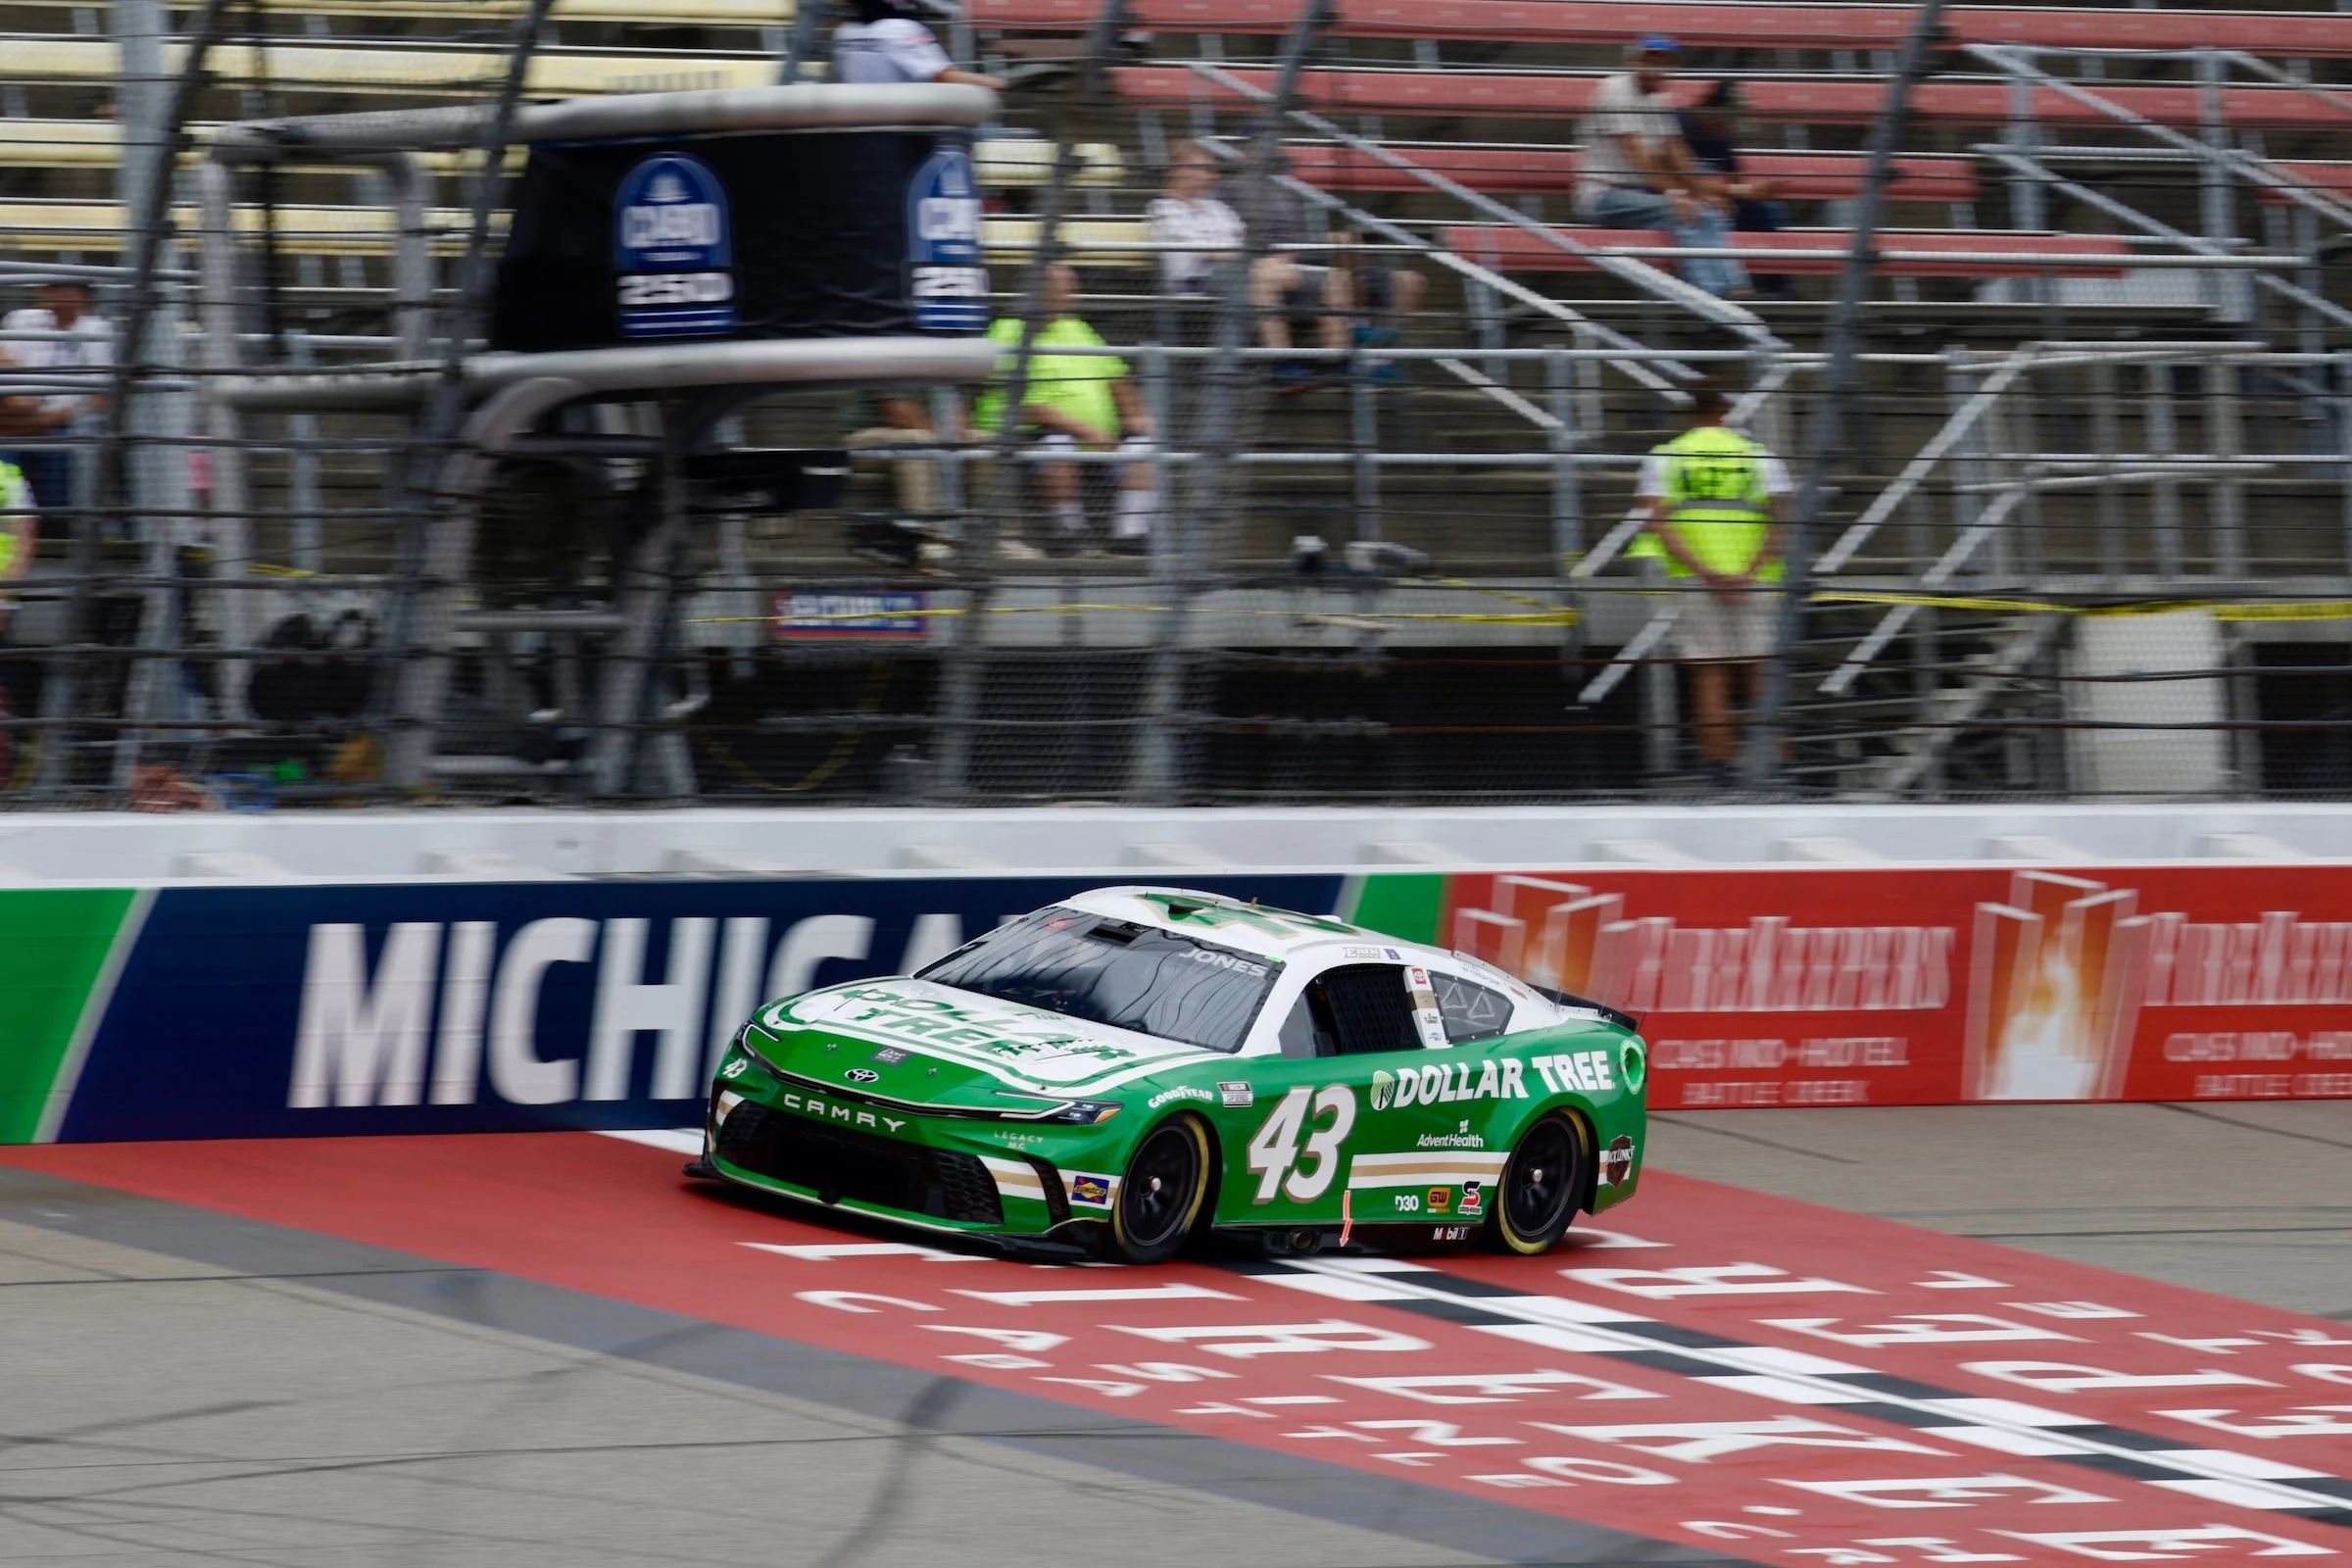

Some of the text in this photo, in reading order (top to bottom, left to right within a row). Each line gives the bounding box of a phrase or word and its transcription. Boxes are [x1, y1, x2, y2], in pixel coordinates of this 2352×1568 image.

[1179, 949, 1267, 978] JONES
[286, 913, 1027, 1108] MICHI
[721, 1057, 748, 1079] 43
[1394, 1057, 1529, 1108] DOLLAR
[1532, 1051, 1615, 1094] TREE
[1148, 1086, 1214, 1108] GOODYEAR
[784, 1093, 906, 1133] CAMRY
[994, 1131, 1045, 1144] LEGACY
[1247, 1084, 1357, 1204] 43
[1417, 1133, 1484, 1148] AdventHealth
[1074, 1185, 1107, 1197] SUNOCO
